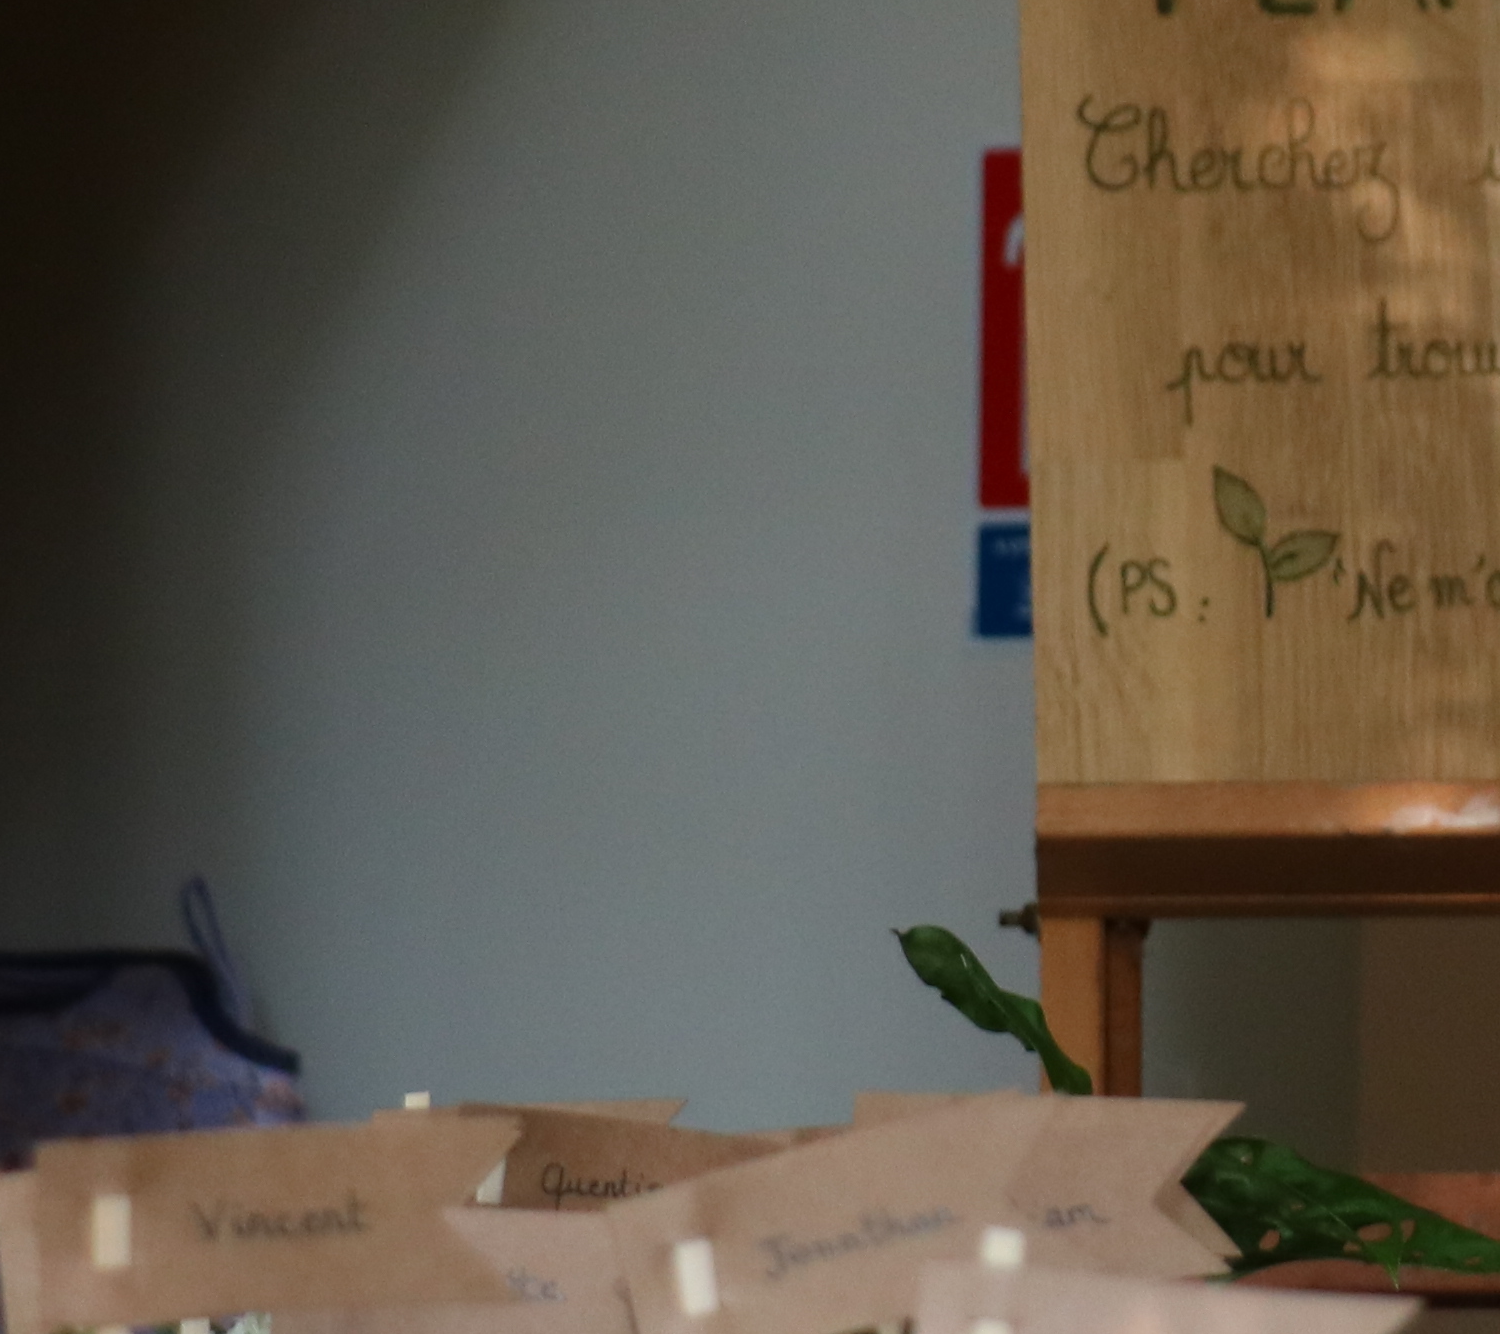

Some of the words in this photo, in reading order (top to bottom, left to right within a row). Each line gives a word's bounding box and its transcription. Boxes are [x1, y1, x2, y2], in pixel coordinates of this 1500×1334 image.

[1078, 95, 1398, 244] Cherchez
[1166, 341, 1323, 426] pour
[188, 1191, 368, 1245] Vincent
